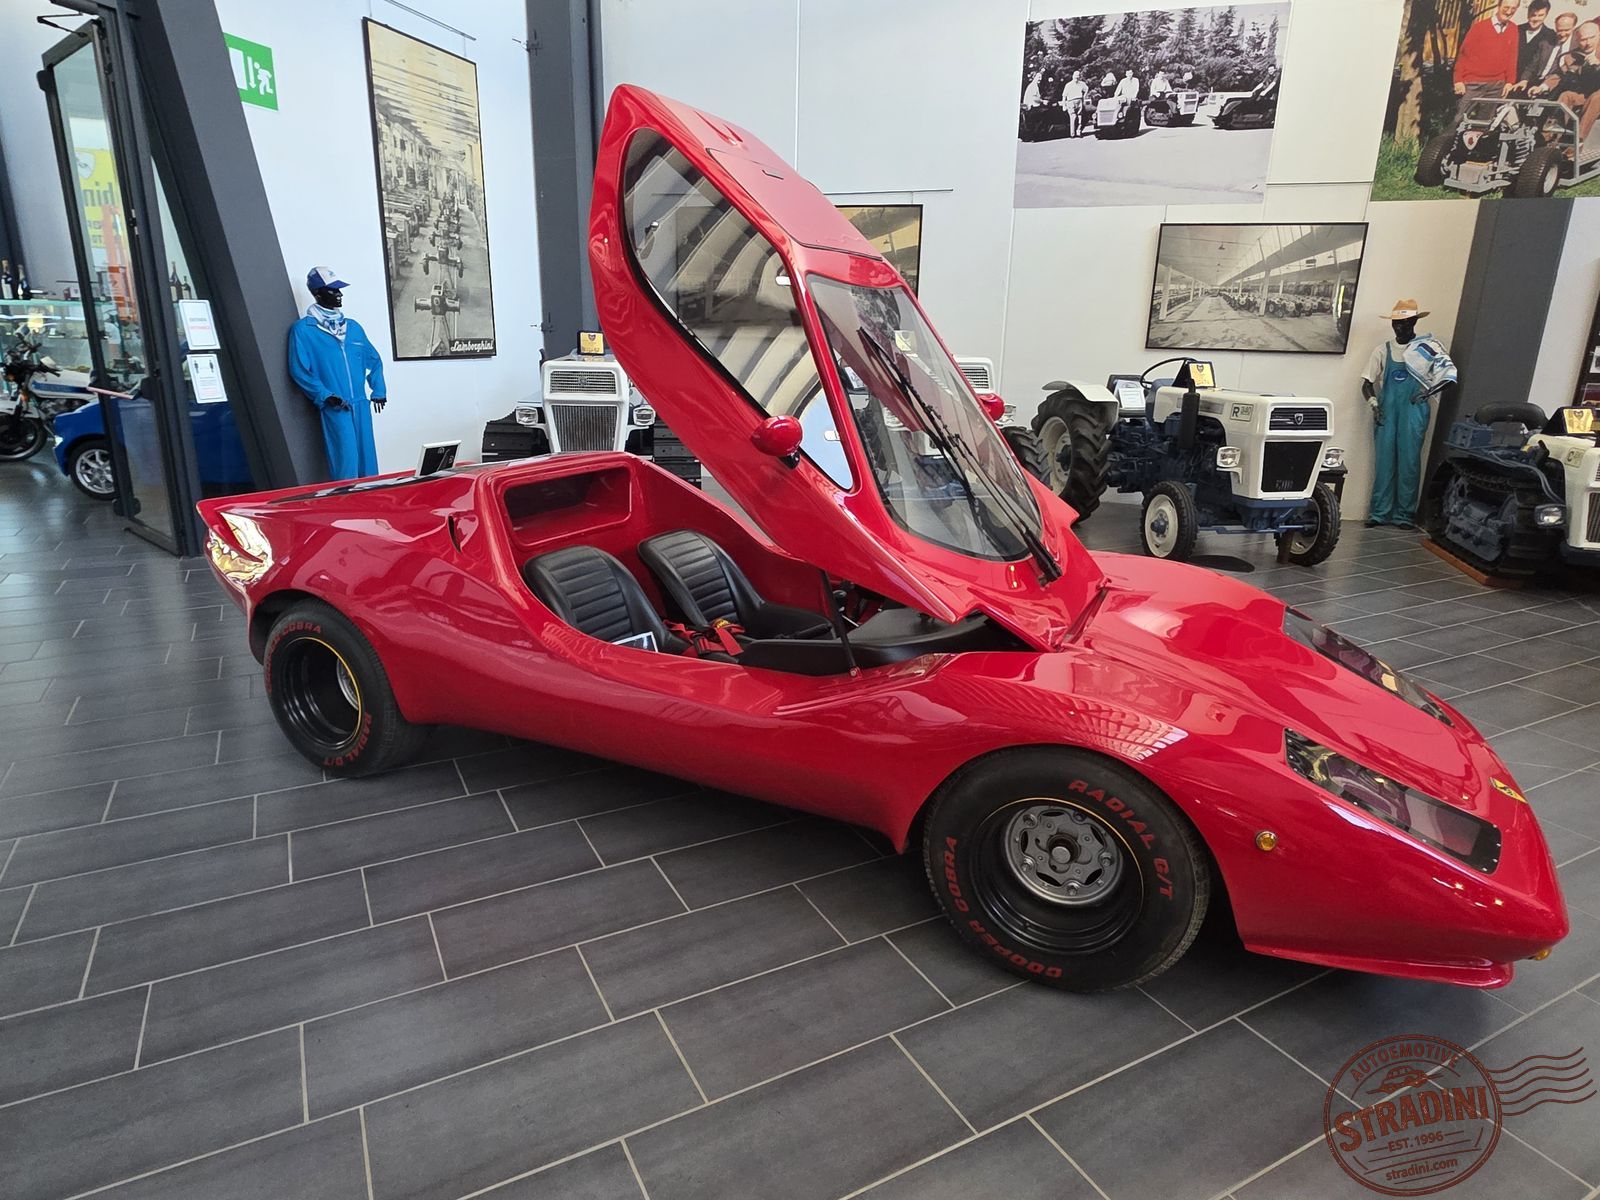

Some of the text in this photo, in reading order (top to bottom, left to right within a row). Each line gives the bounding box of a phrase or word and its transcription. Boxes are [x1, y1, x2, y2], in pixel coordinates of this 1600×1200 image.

[450, 340, 494, 352] Lamborghini
[282, 621, 321, 636] COBRA
[1068, 780, 1155, 849] RADIAL
[944, 836, 1062, 978] COOPER COBRA
